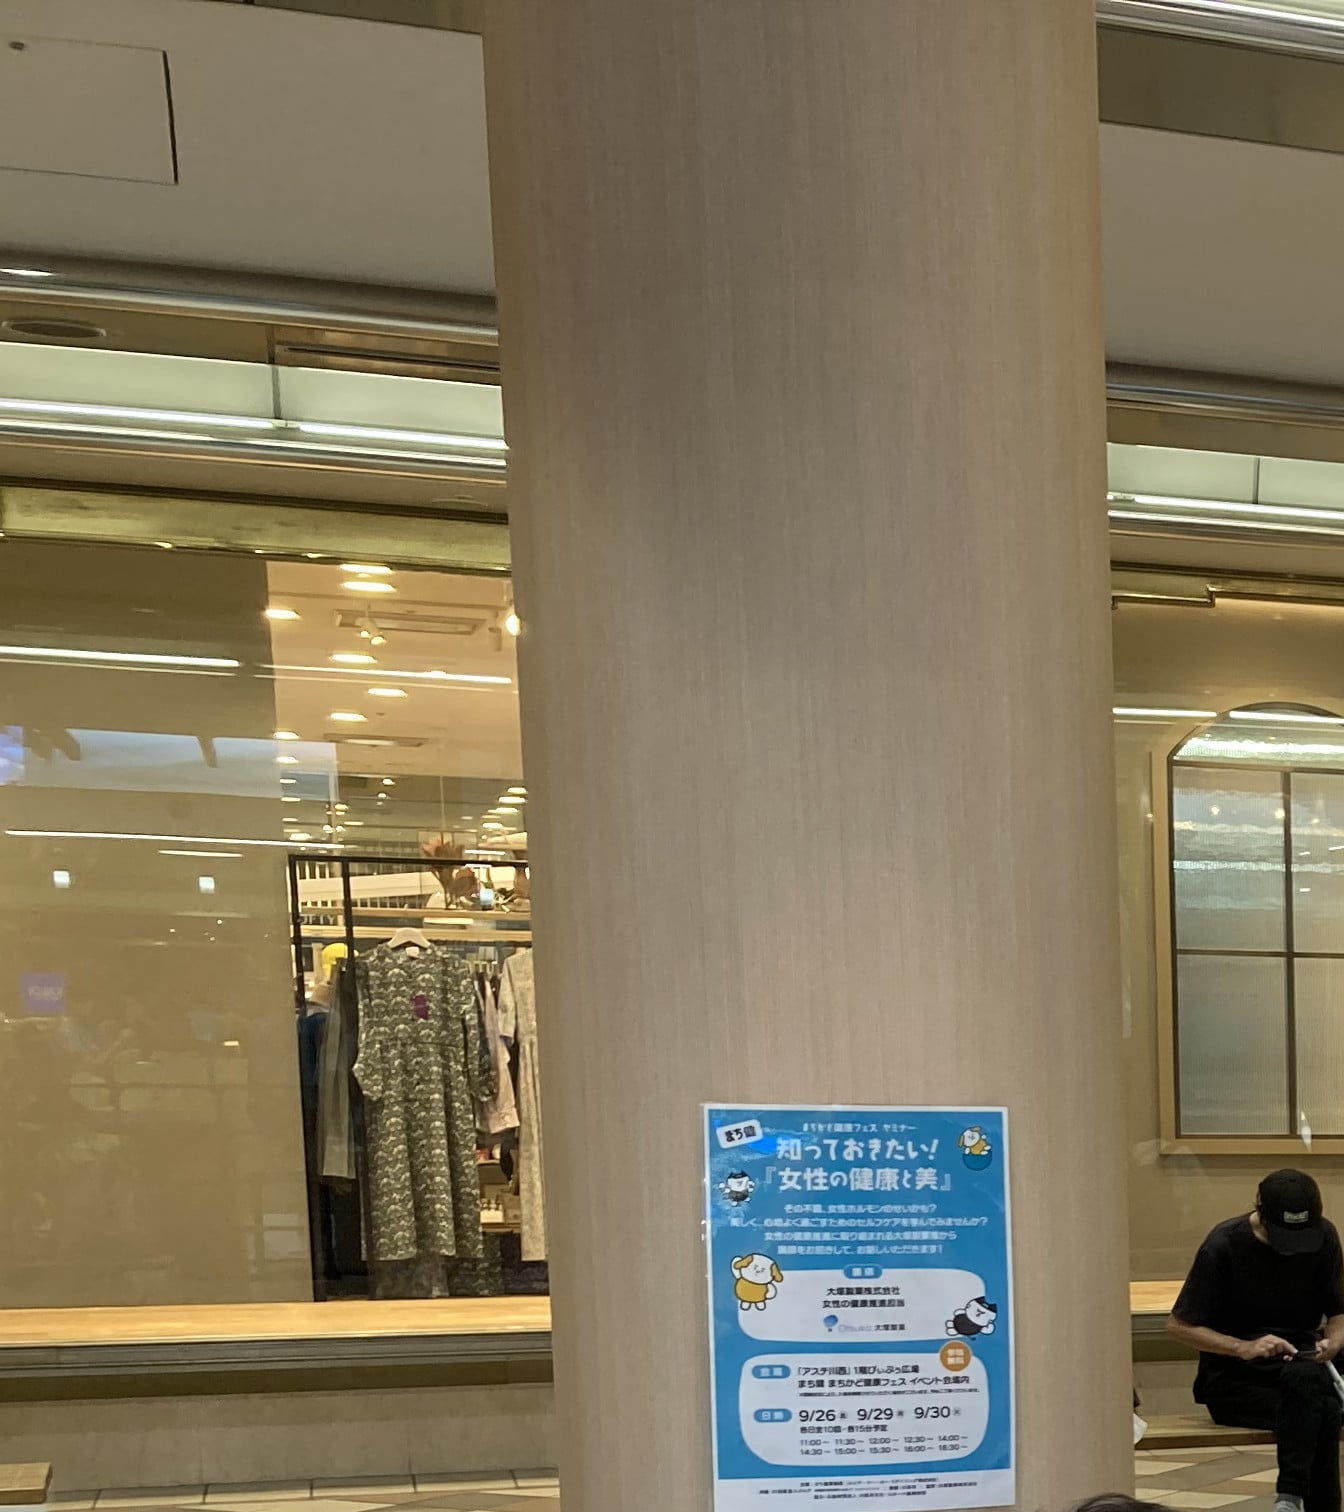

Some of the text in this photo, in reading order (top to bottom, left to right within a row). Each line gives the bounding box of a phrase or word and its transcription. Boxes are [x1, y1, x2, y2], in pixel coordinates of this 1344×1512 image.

[775, 1138, 940, 1161] 知っておきたい!
[764, 1166, 952, 1192] 『女性の健康と美』
[798, 1409, 836, 1422] 9/26
[857, 1408, 894, 1421] 9/29
[914, 1405, 951, 1419] 9/30
